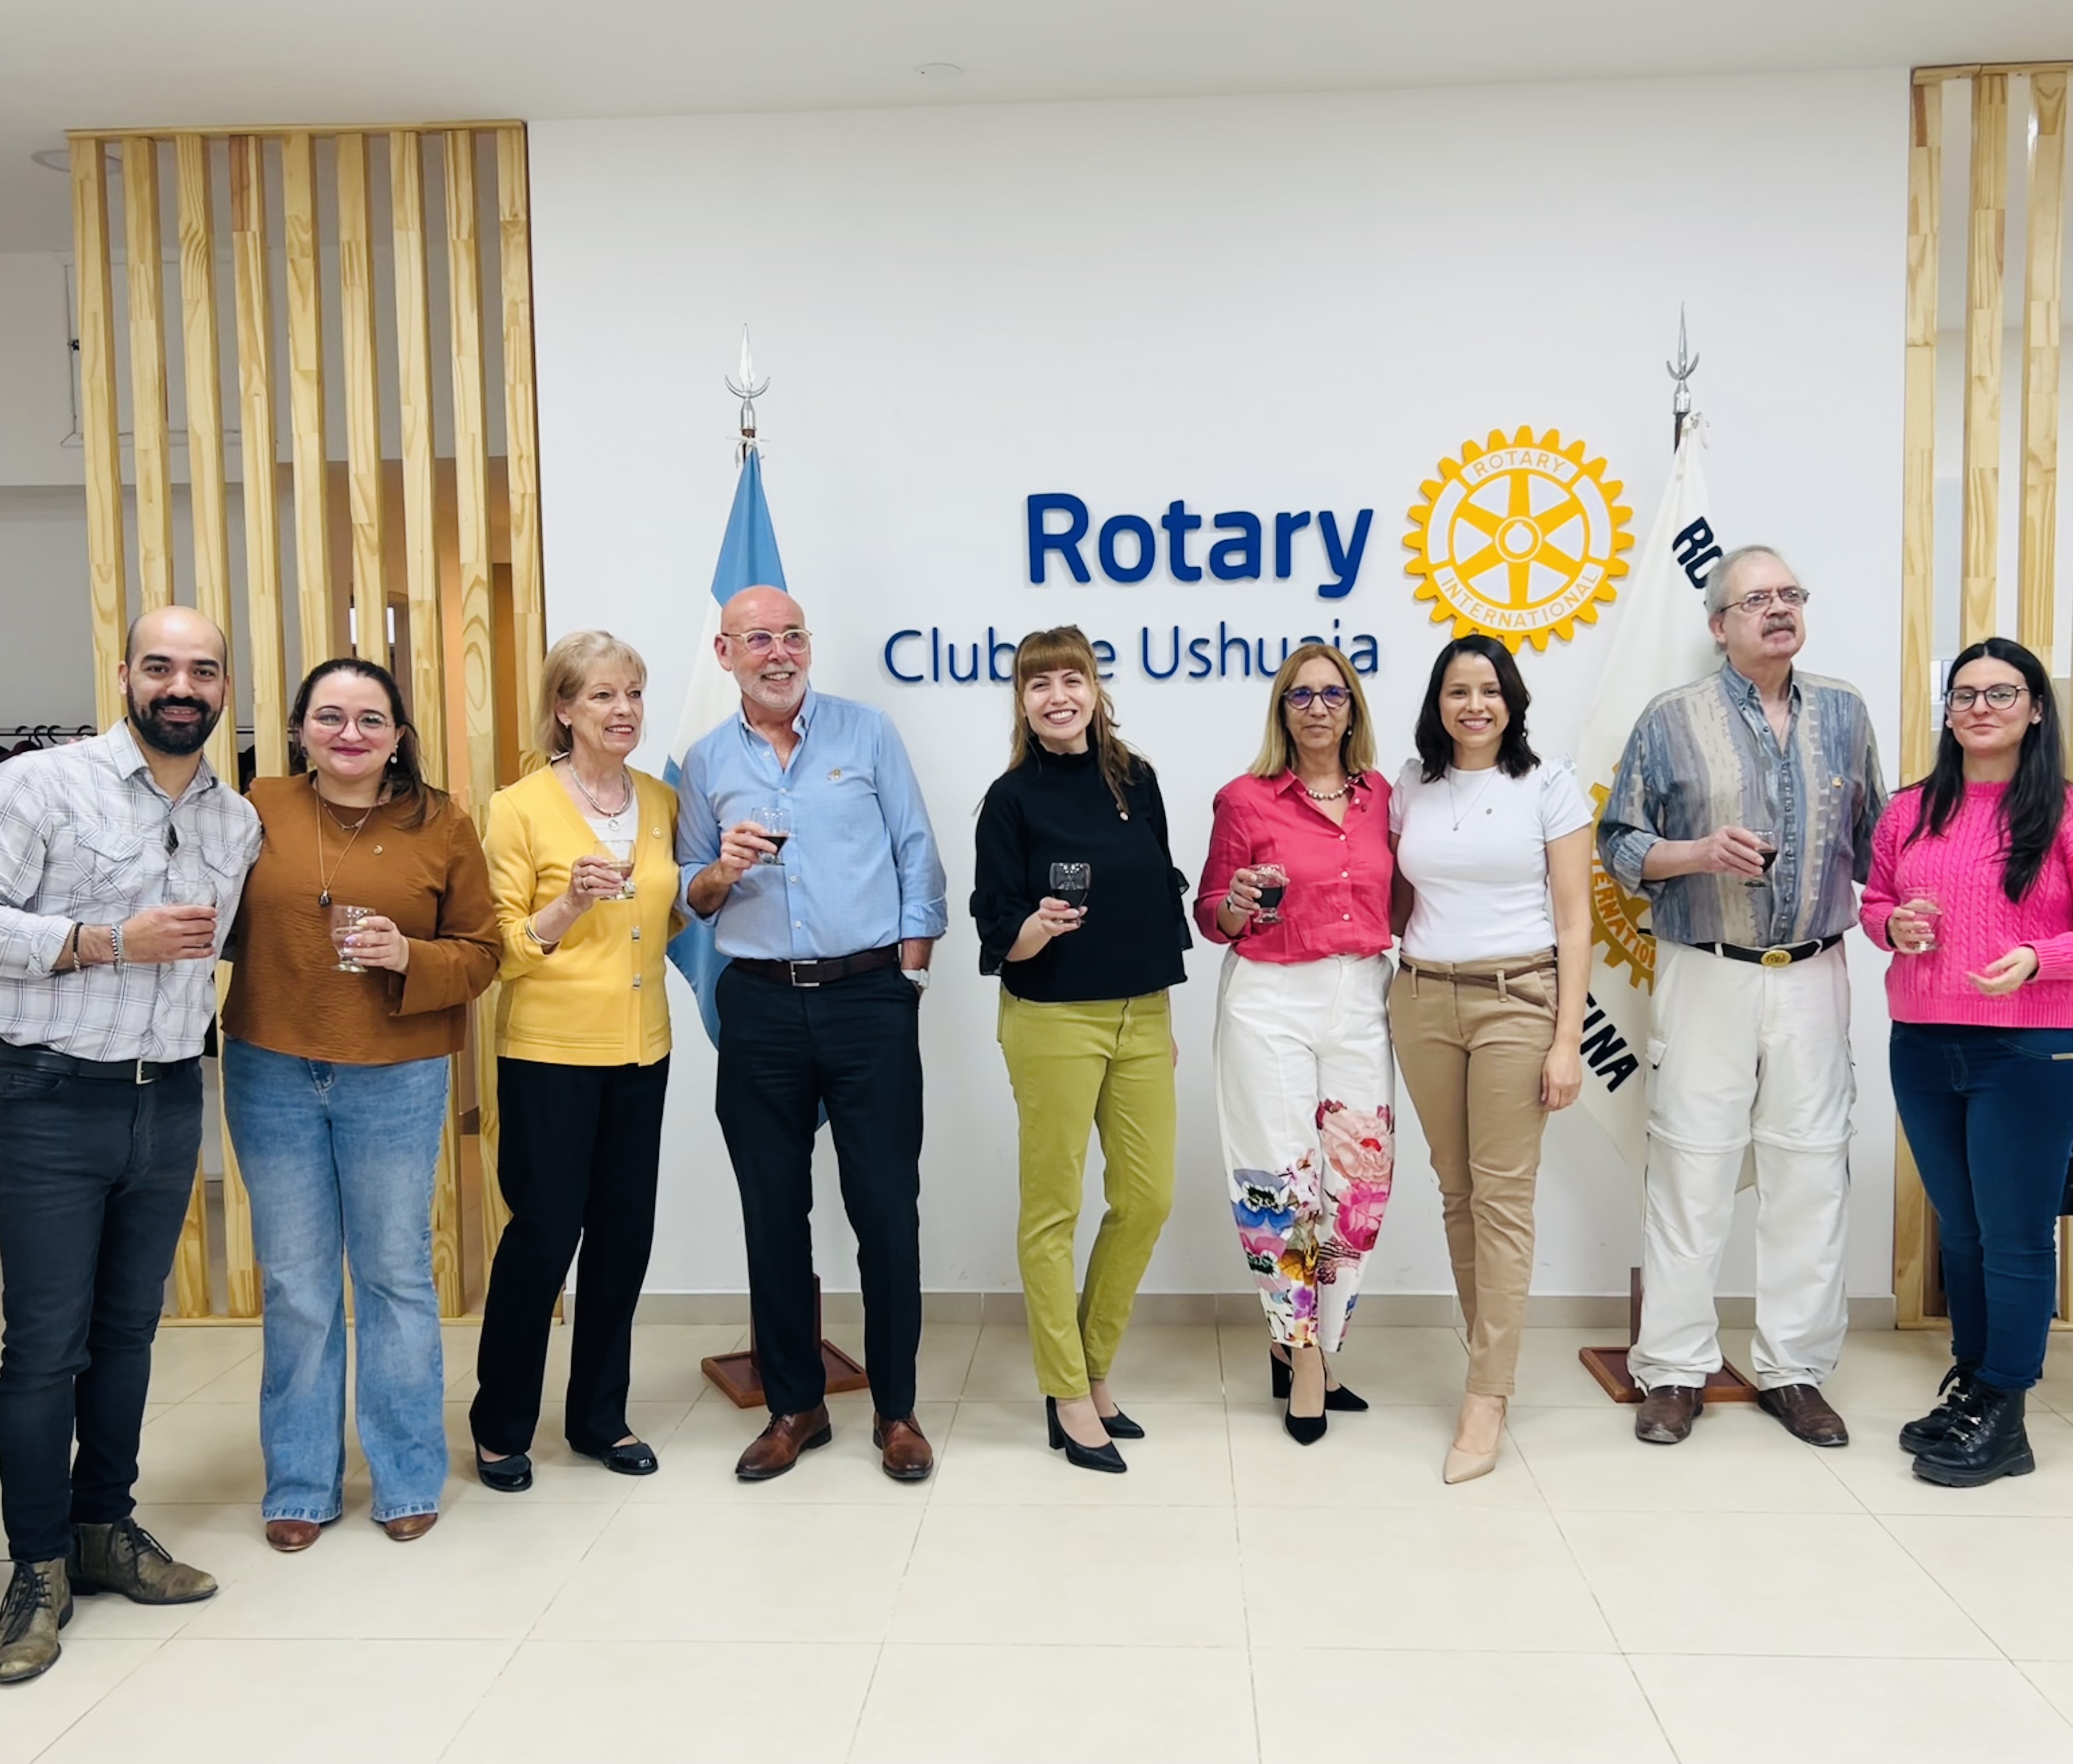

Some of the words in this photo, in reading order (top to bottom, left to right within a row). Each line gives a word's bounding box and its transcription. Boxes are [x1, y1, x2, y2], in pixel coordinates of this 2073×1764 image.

[1473, 450, 1566, 477] ROTARY
[1027, 493, 1374, 598] Rotary
[1441, 573, 1599, 628] INTERNATIONAL
[884, 627, 1016, 682] Club
[1142, 620, 1378, 680] Ushuia
[1580, 992, 1639, 1093] INA
